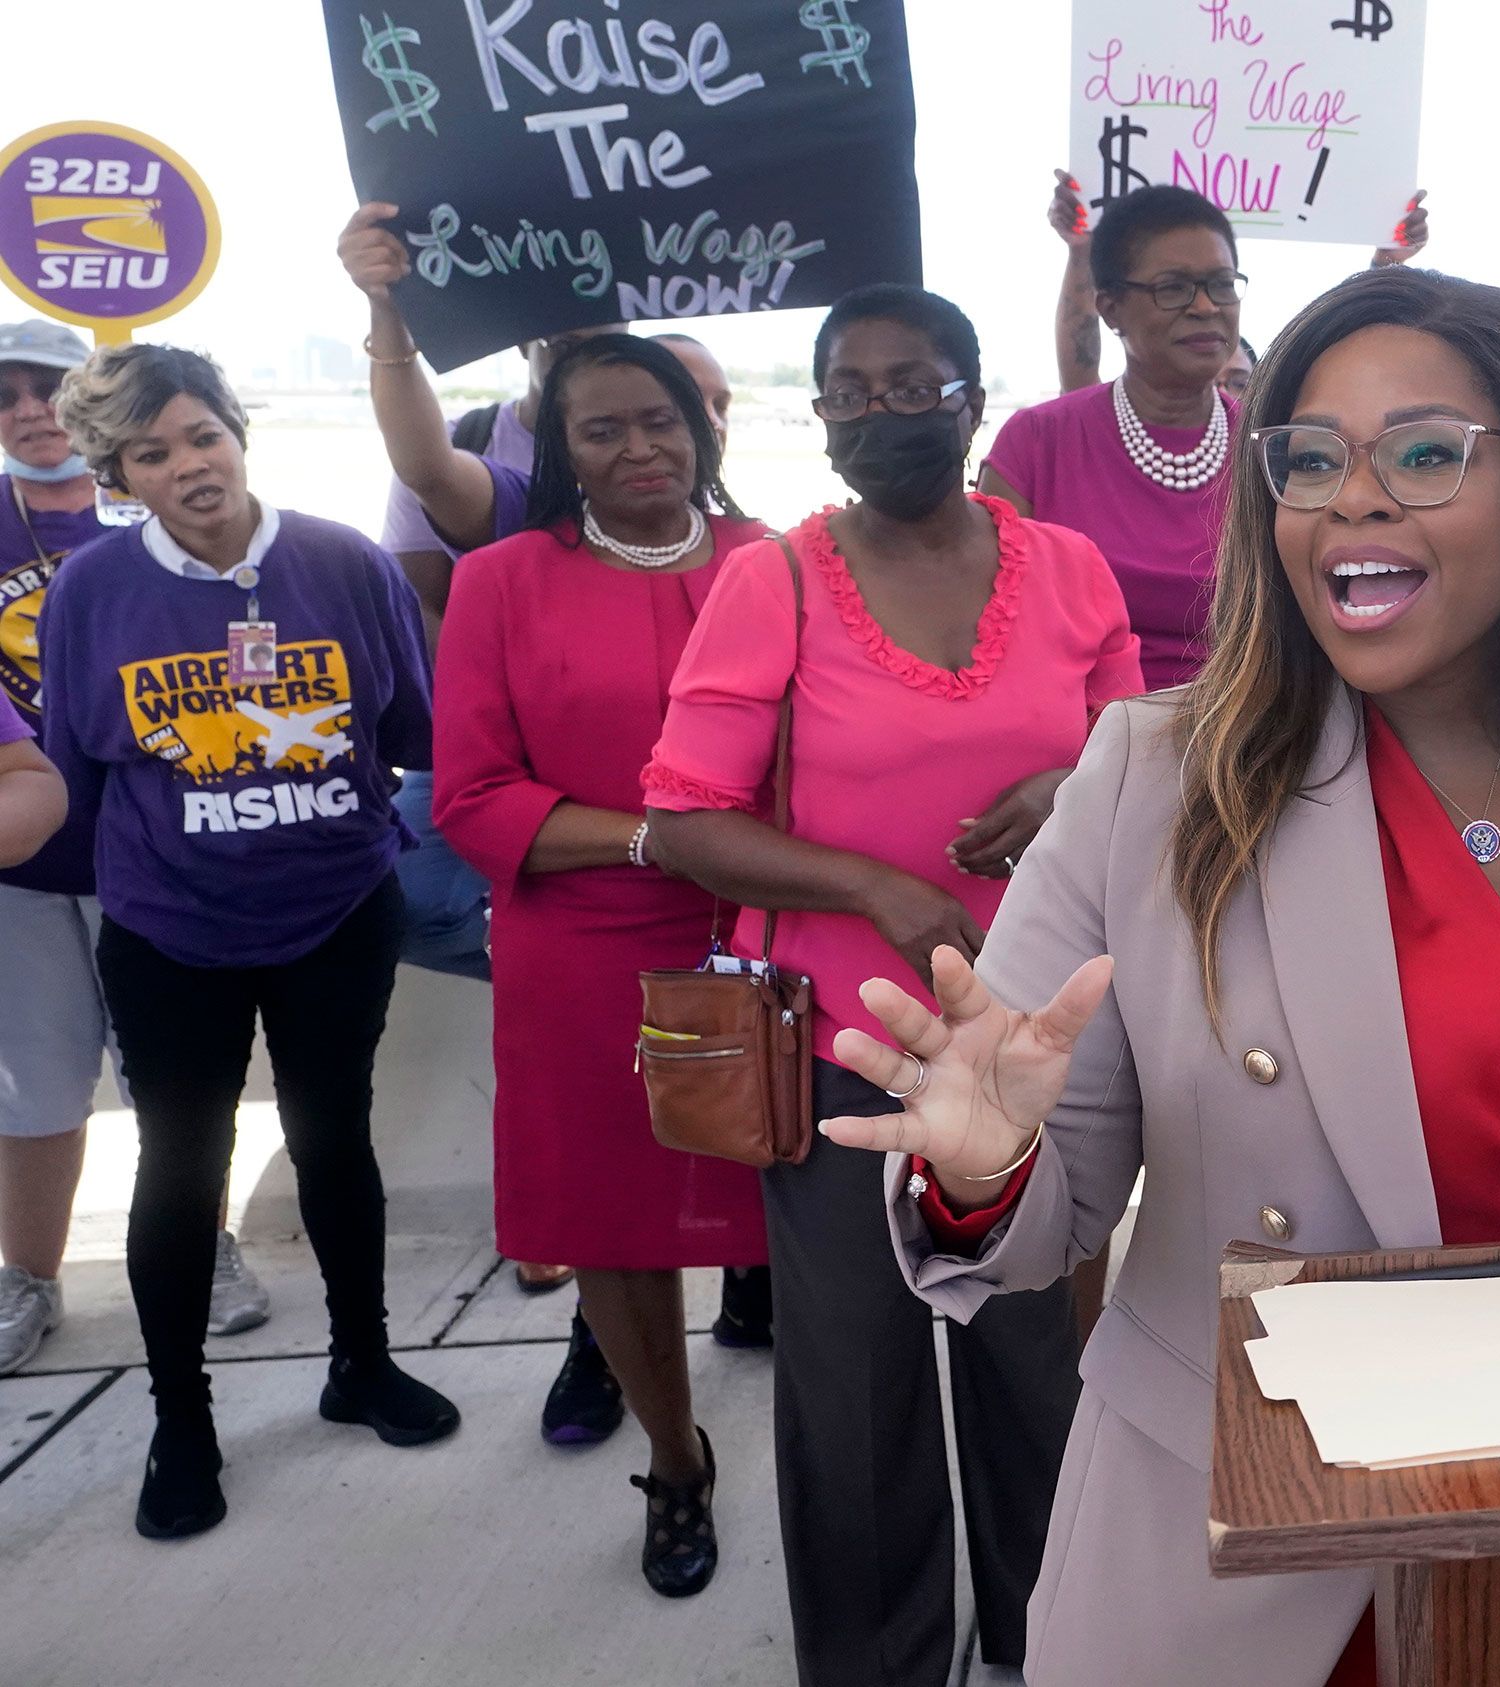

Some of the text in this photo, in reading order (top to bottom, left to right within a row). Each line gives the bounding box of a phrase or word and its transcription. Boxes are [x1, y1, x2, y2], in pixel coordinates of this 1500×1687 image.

[464, 0, 764, 112] Raise
[1085, 38, 1361, 150] Living Wage
[24, 157, 162, 196] 32BJ
[526, 103, 711, 199] The
[37, 256, 169, 290] SEIU
[406, 203, 613, 298] Living
[616, 261, 796, 321] NOW!
[134, 646, 333, 698] AIRPRT
[137, 677, 338, 724] WORKERS
[183, 777, 360, 834] RISING
